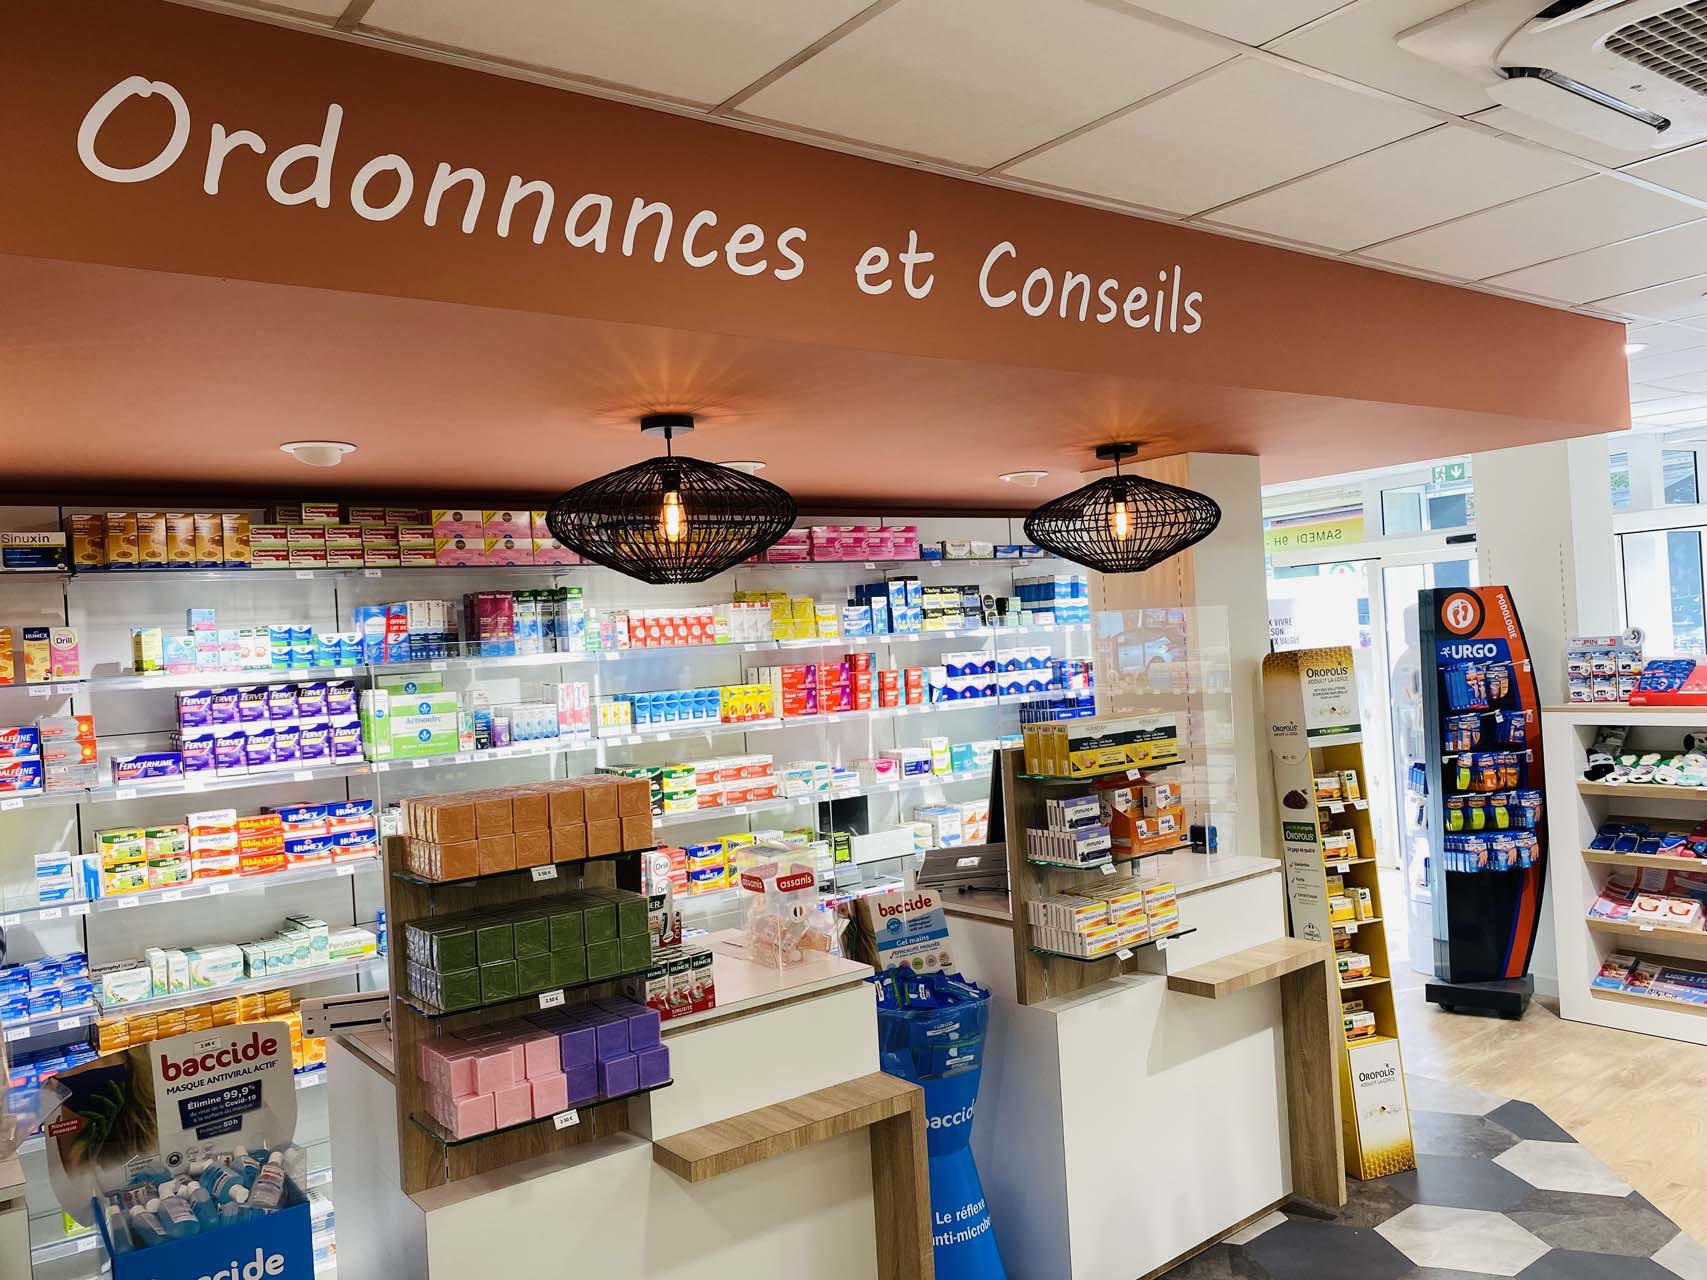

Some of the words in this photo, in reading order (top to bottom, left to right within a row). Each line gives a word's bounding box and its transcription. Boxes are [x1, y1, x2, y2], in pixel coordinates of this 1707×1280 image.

[77, 75, 806, 281] Ordonnances
[855, 229, 935, 299] et
[978, 240, 1203, 334] Conseils
[0, 533, 50, 544] Sinuxin
[1273, 618, 1293, 626] VIVRE
[1495, 593, 1518, 640] PODOLOGIE
[393, 633, 400, 642] 2
[1270, 628, 1285, 636] SON
[1451, 643, 1497, 659] URGO
[1306, 667, 1348, 678] OROPOLIS
[241, 692, 268, 701] FERVEX
[271, 690, 298, 700] FERVEX
[300, 688, 327, 697] FERVEX
[329, 686, 355, 696] FERVEX
[182, 696, 211, 706] FERVEX
[212, 695, 239, 704] FERVEX
[302, 729, 328, 739] FERVEX
[335, 726, 361, 736] FERVEX
[184, 740, 214, 750] FERVEX
[217, 737, 245, 747] FERVEX
[248, 735, 275, 744] FERVEX
[119, 760, 147, 771] FERVEX
[147, 759, 174, 768] RHUME
[288, 811, 318, 822] HUMEX
[335, 806, 364, 816] HUMEX
[340, 834, 368, 845] HUMEX
[293, 842, 323, 853] HUMEX
[780, 875, 812, 888] assanis
[877, 894, 932, 917] baccide
[896, 937, 909, 947] Gel
[909, 934, 930, 944] mains
[160, 1031, 278, 1081] baccide
[166, 1079, 205, 1095] MASQUE
[206, 1066, 252, 1085] ANTIVIRAL
[253, 1059, 278, 1073] ACTIF
[1358, 1068, 1395, 1082] OROPOLIS
[187, 1096, 222, 1110] Élimine
[225, 1094, 257, 1108] Covid-19
[925, 1097, 975, 1129] accid
[936, 1211, 952, 1225] Le
